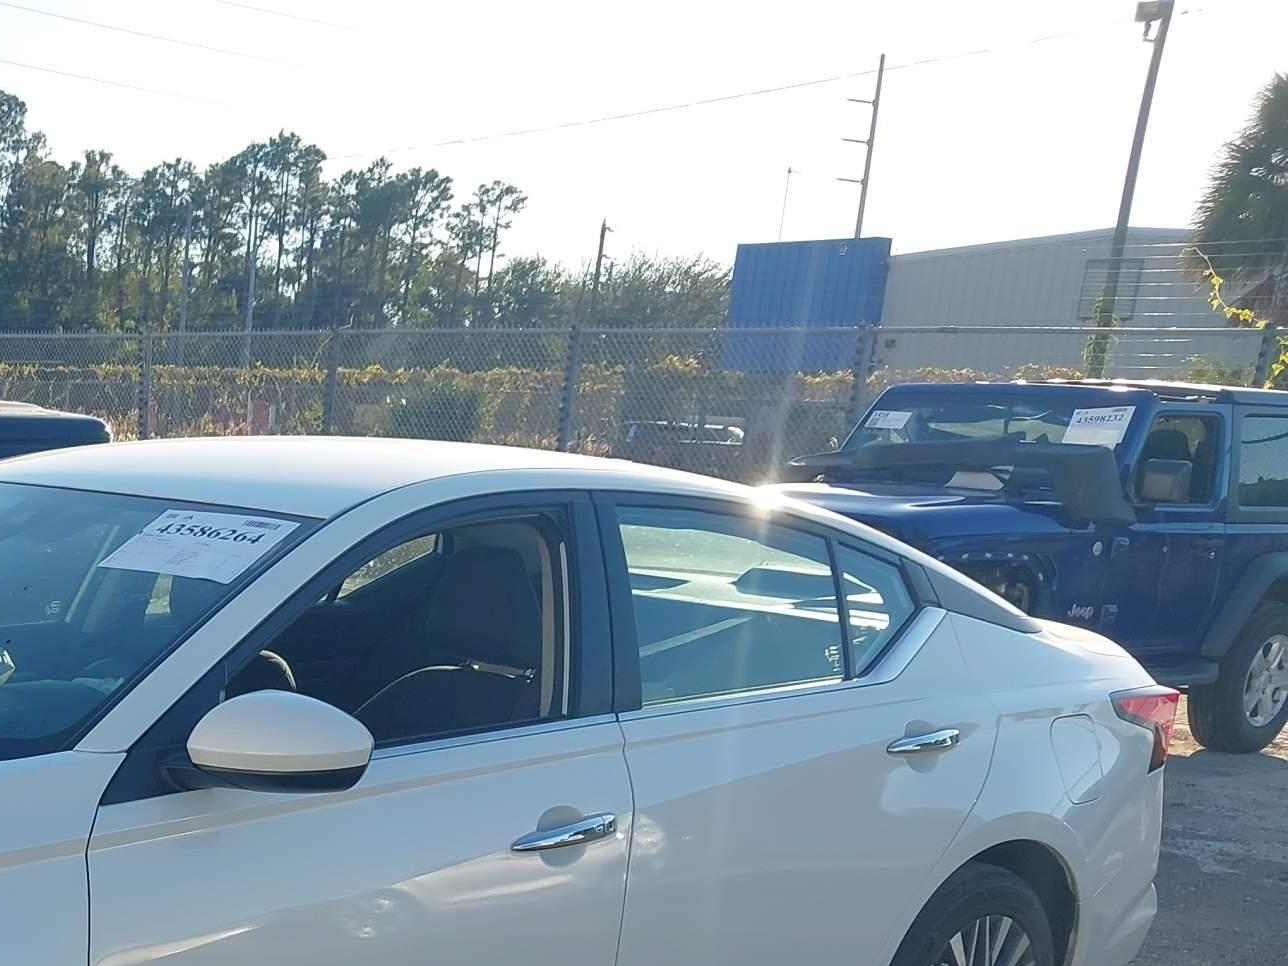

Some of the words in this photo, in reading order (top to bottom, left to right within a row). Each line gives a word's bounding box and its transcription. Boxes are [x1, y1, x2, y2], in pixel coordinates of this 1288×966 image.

[1075, 413, 1125, 424] 43598232
[156, 522, 266, 545] 43586264
[1066, 603, 1094, 620] Jeep
